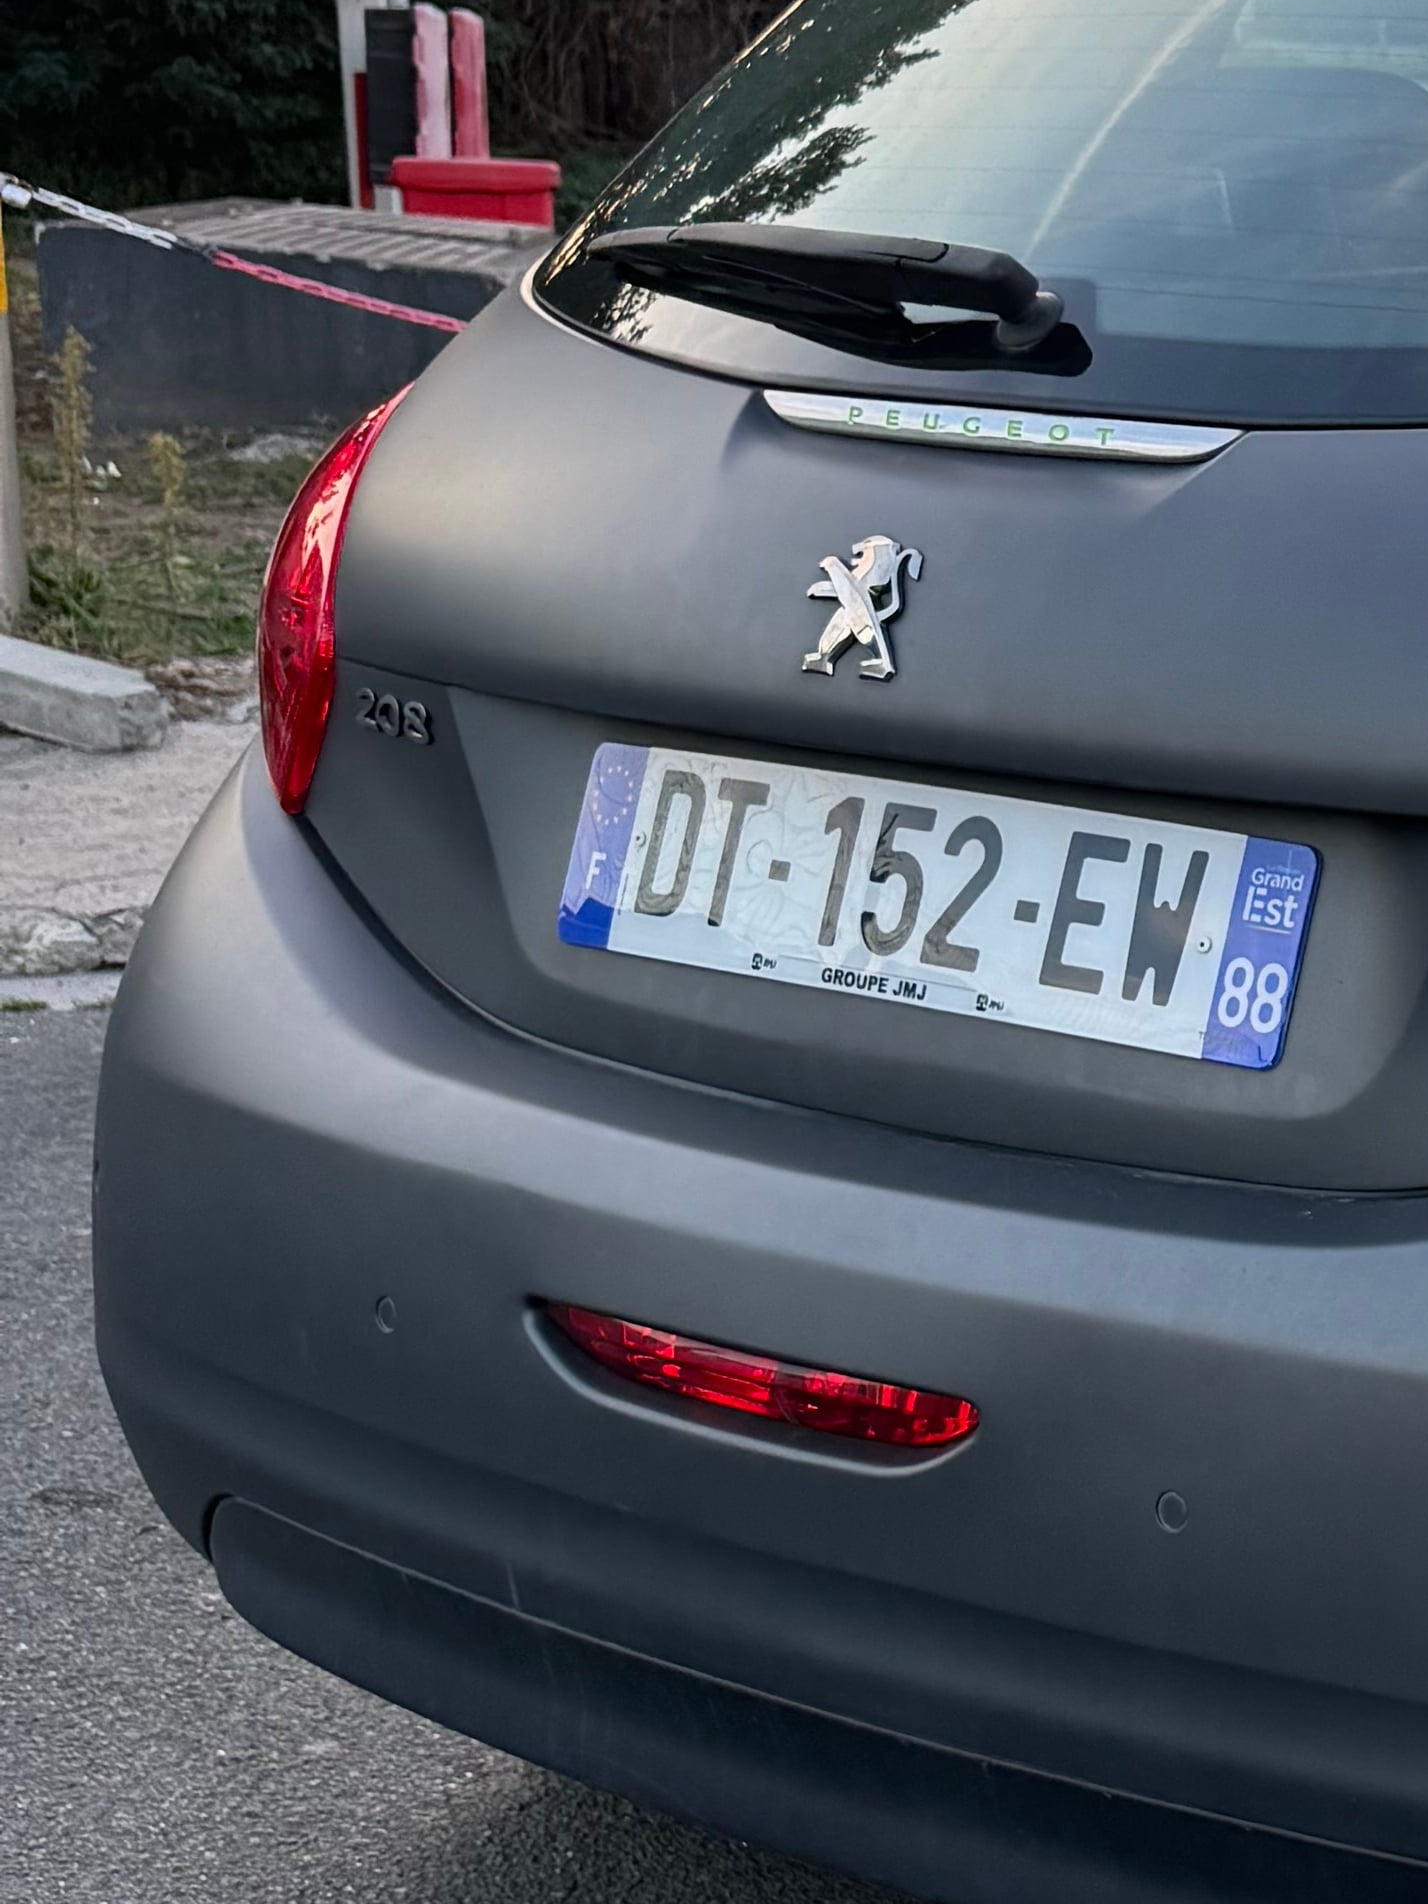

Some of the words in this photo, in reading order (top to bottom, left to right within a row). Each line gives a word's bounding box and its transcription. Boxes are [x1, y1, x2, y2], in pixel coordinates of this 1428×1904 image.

[847, 405, 1115, 446] PEUGEOT
[356, 687, 431, 746] 208
[585, 851, 607, 890] F
[634, 769, 1210, 1007] DT-152-EW
[1250, 867, 1305, 892] Grand
[1242, 885, 1299, 928] Est
[820, 967, 889, 993] GROUPE
[892, 980, 927, 1001] JMJ
[1217, 956, 1289, 1034] 88
